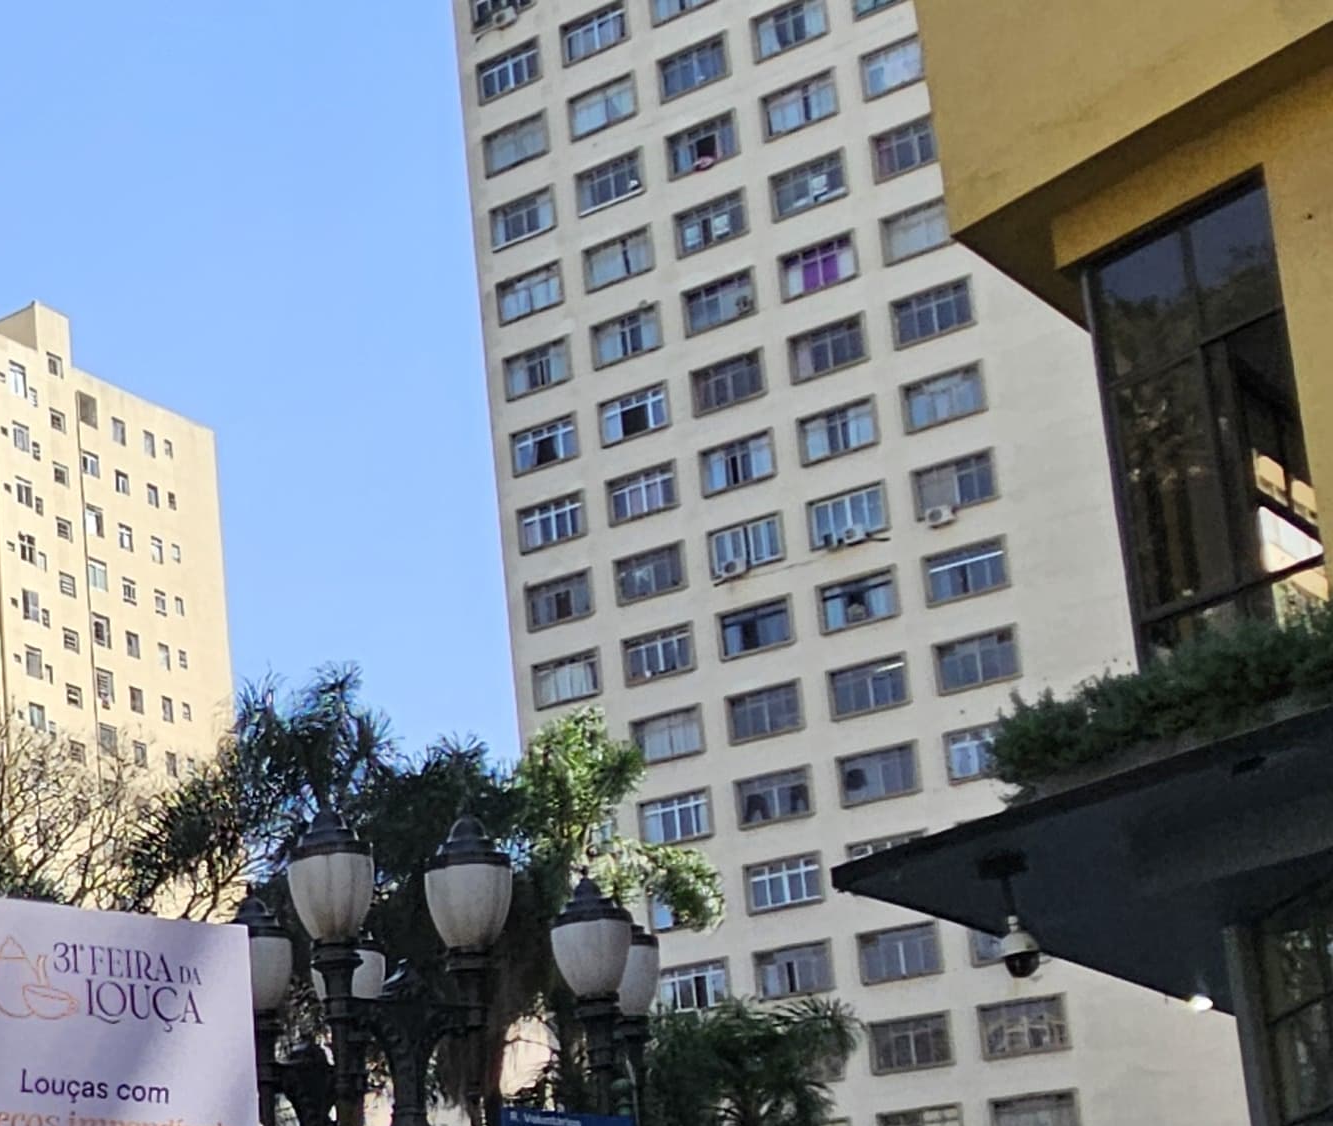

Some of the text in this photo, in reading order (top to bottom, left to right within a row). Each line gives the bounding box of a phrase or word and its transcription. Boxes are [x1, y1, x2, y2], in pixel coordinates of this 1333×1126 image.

[89, 946, 173, 984] FEIRA
[179, 964, 203, 986] DA
[87, 978, 205, 1032] LOUÇA
[20, 1069, 170, 1105] Louças com
